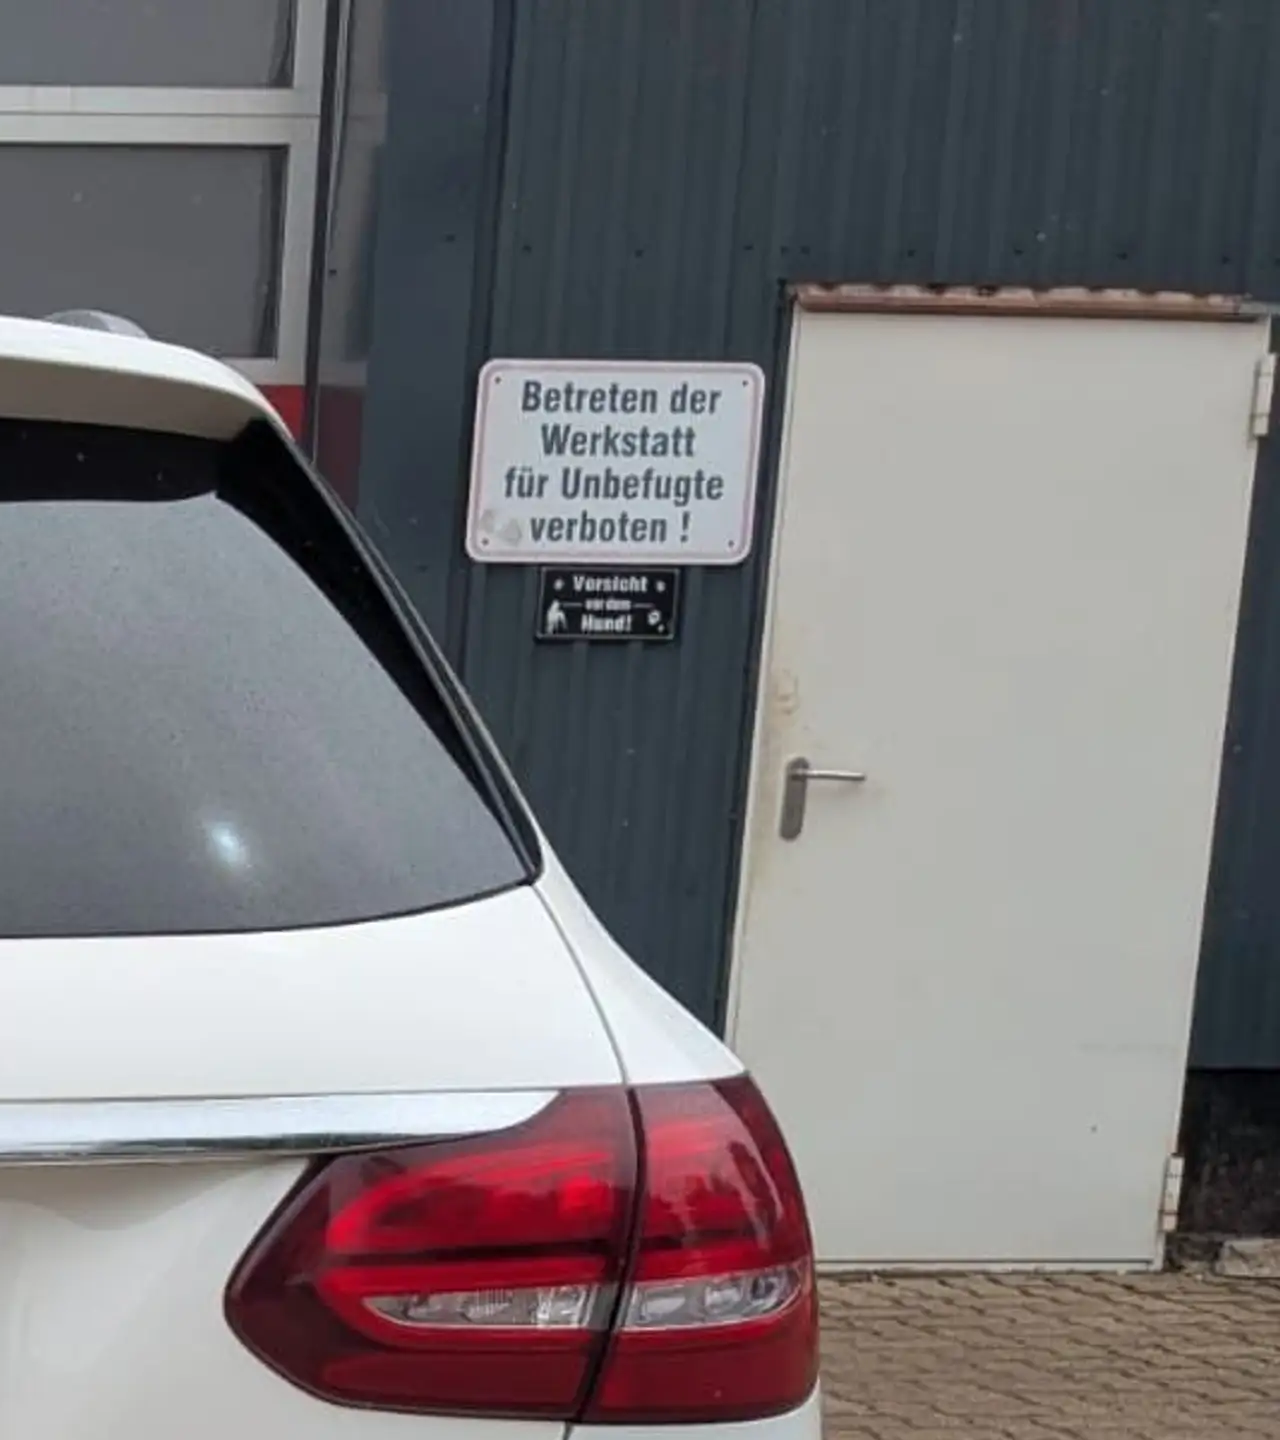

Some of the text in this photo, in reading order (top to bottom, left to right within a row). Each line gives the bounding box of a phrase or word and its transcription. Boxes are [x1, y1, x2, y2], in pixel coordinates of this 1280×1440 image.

[521, 379, 722, 415] Betreten der
[540, 423, 696, 458] Werkstatt
[504, 466, 724, 508] für Unbefugte
[530, 509, 691, 543] verboten !
[572, 575, 648, 593] Vorsicht
[580, 614, 633, 632] Hund!
